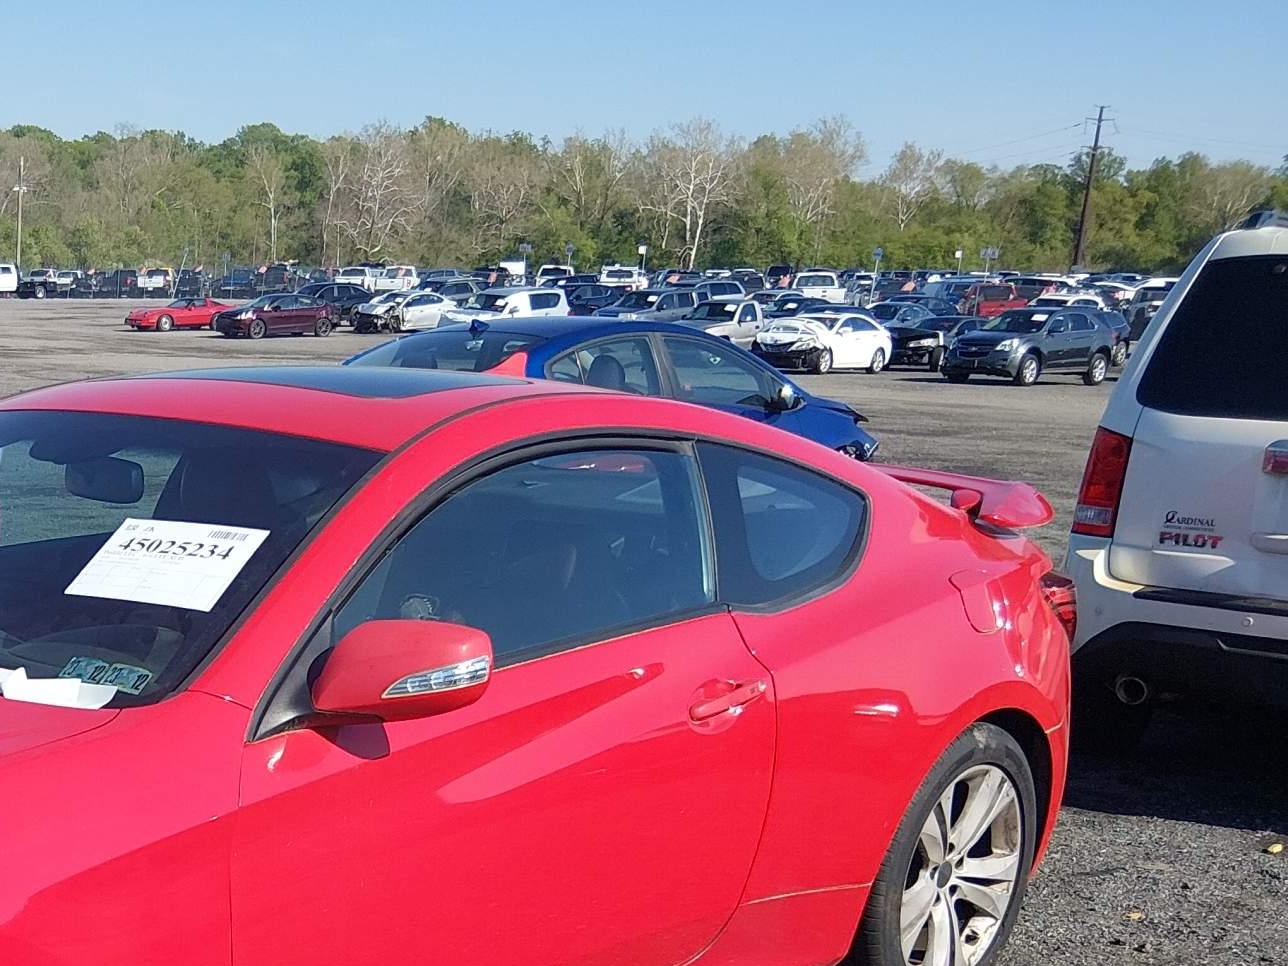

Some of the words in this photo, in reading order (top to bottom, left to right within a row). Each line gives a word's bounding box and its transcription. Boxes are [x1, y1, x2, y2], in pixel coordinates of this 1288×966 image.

[118, 537, 235, 560] 45025234
[1159, 531, 1224, 549] PILOT
[87, 665, 107, 681] 12
[130, 673, 150, 690] 12
